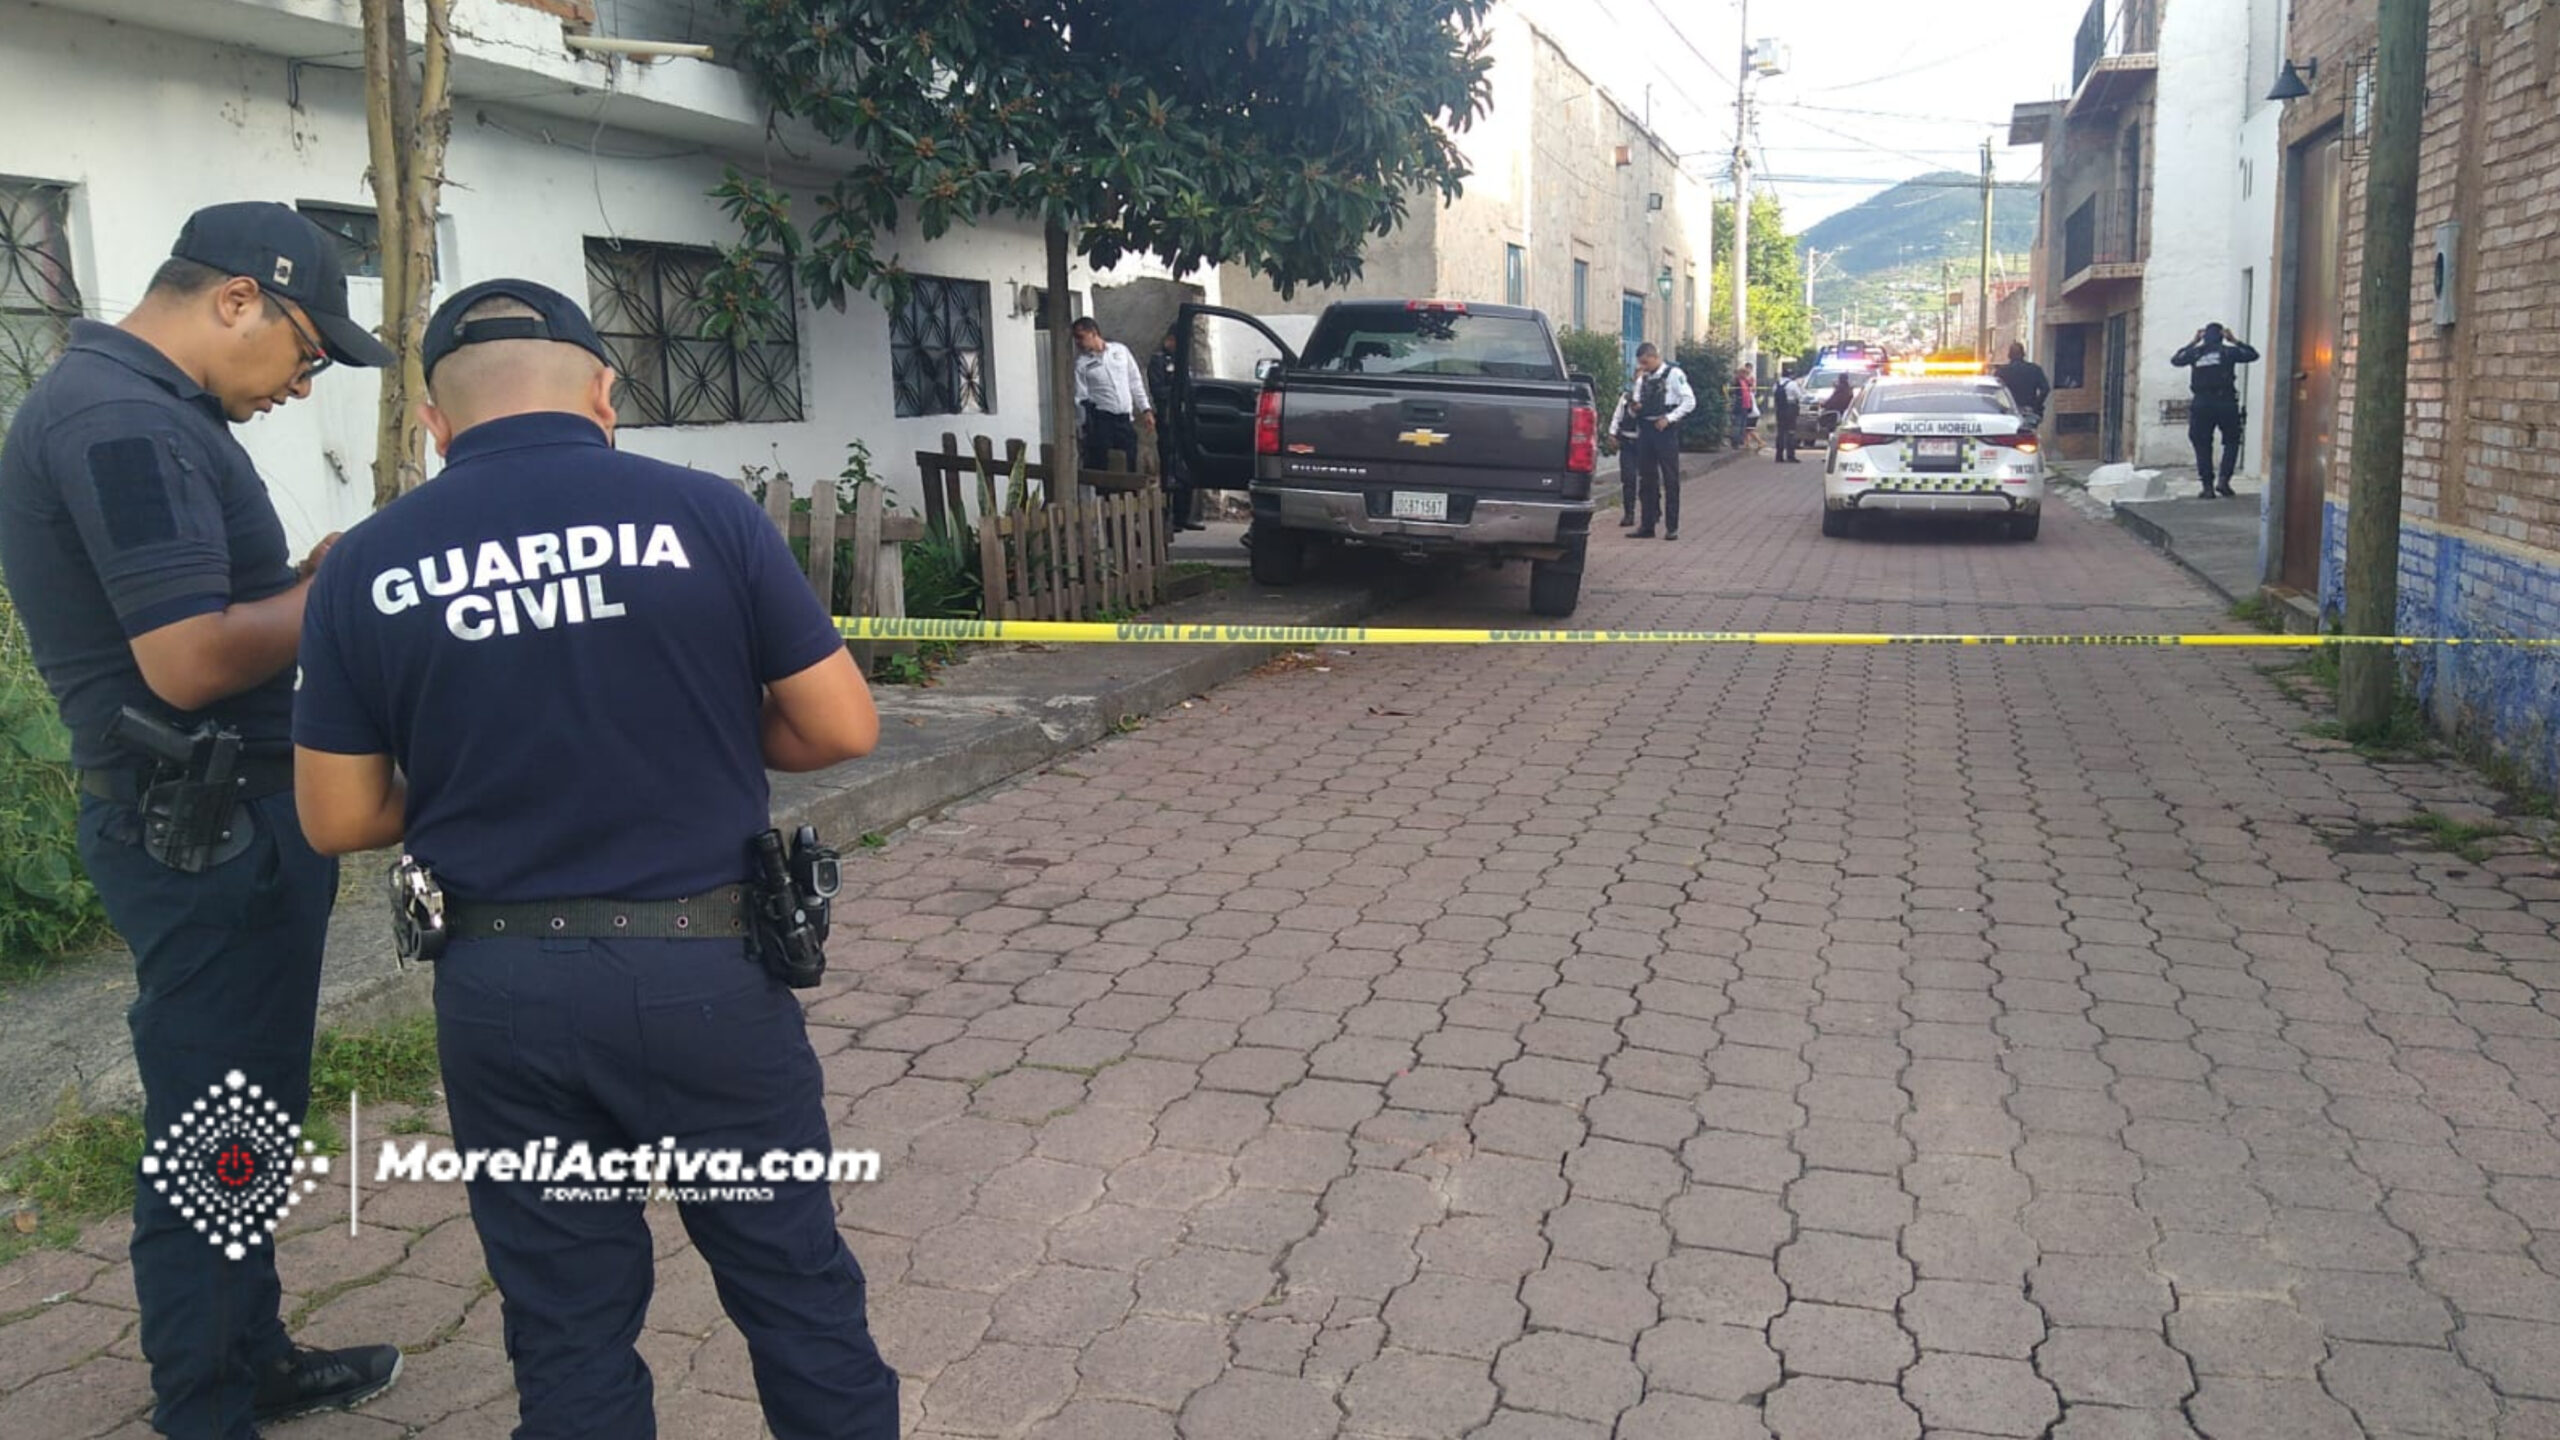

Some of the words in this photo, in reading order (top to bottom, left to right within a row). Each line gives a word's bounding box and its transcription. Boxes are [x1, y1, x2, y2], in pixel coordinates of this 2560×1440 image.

[1938, 423, 1982, 433] MORELIA
[371, 523, 690, 615] GUARDIA
[446, 574, 626, 641] CIVIL
